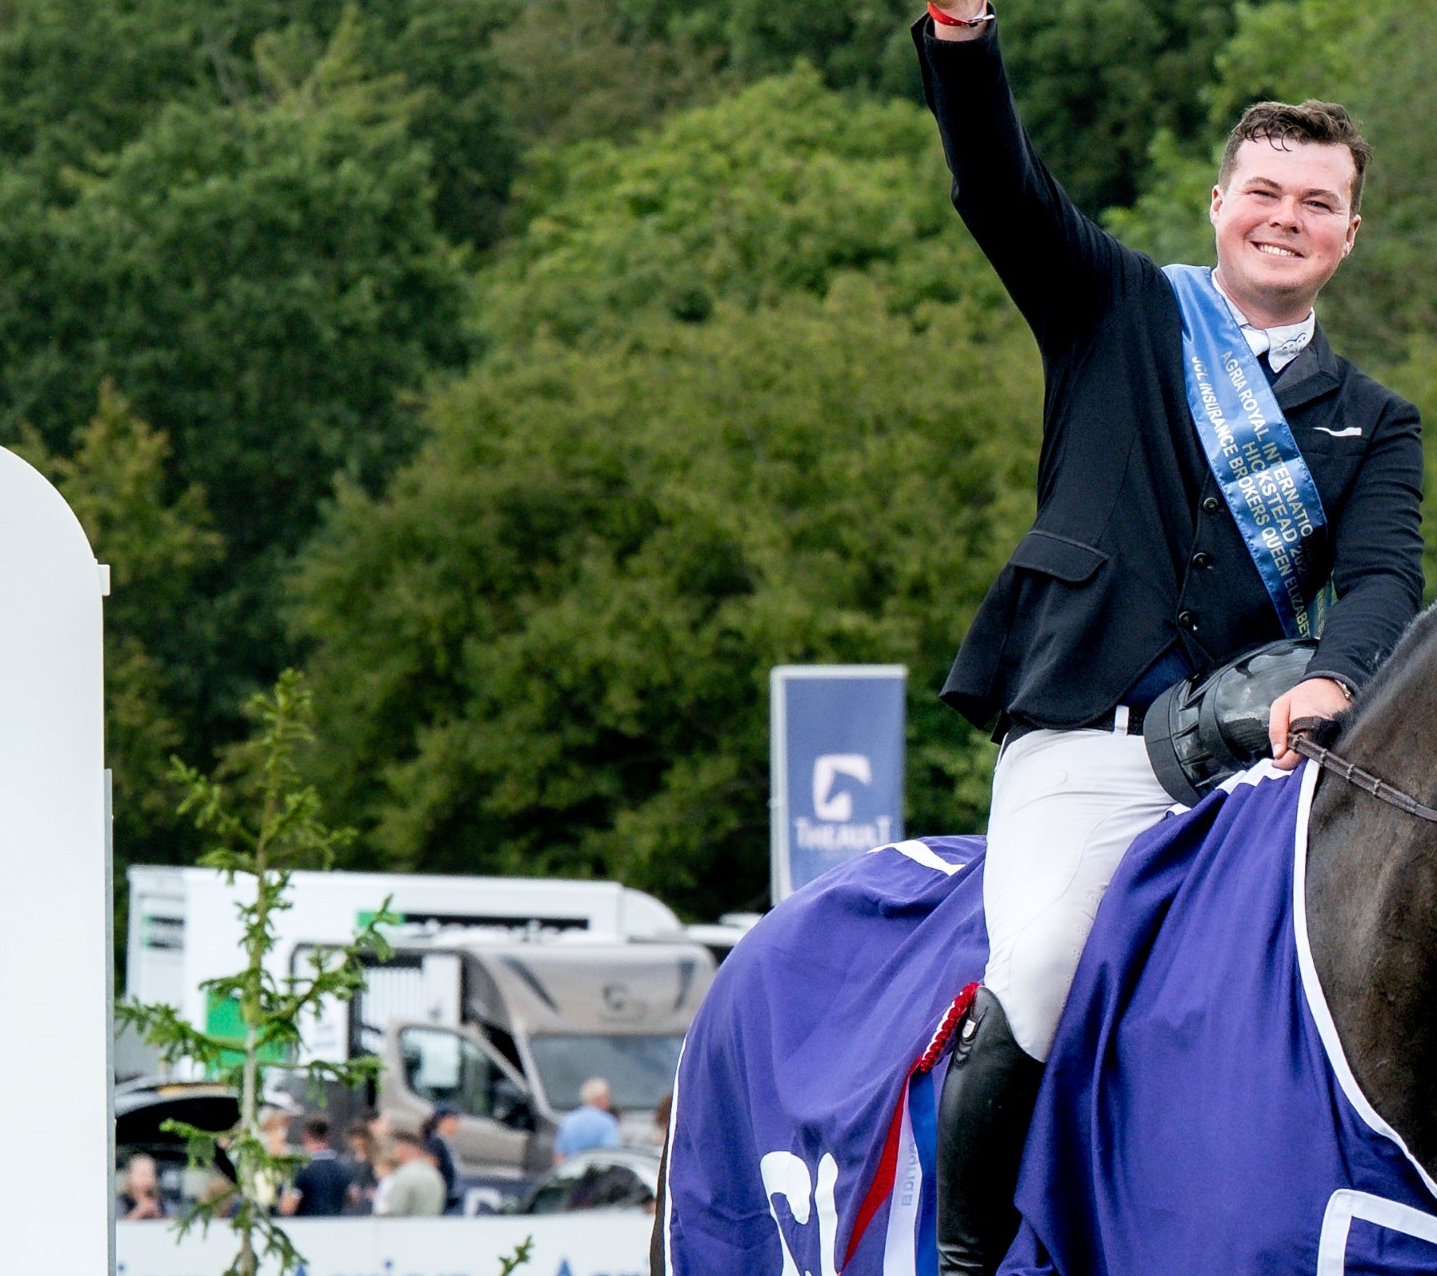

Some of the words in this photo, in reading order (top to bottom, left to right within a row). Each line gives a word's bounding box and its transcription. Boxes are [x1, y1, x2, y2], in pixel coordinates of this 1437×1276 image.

[1199, 382, 1239, 457] INSURANCE
[1229, 456, 1270, 526] BROKERS
[1261, 527, 1293, 577] QUEEN
[1284, 576, 1311, 638] ELIZABET
[1221, 350, 1247, 392] AGRIA
[1238, 388, 1269, 442] ROYAL
[1262, 442, 1314, 538] INTERNATIO
[1242, 441, 1298, 542] HICKSTEAD
